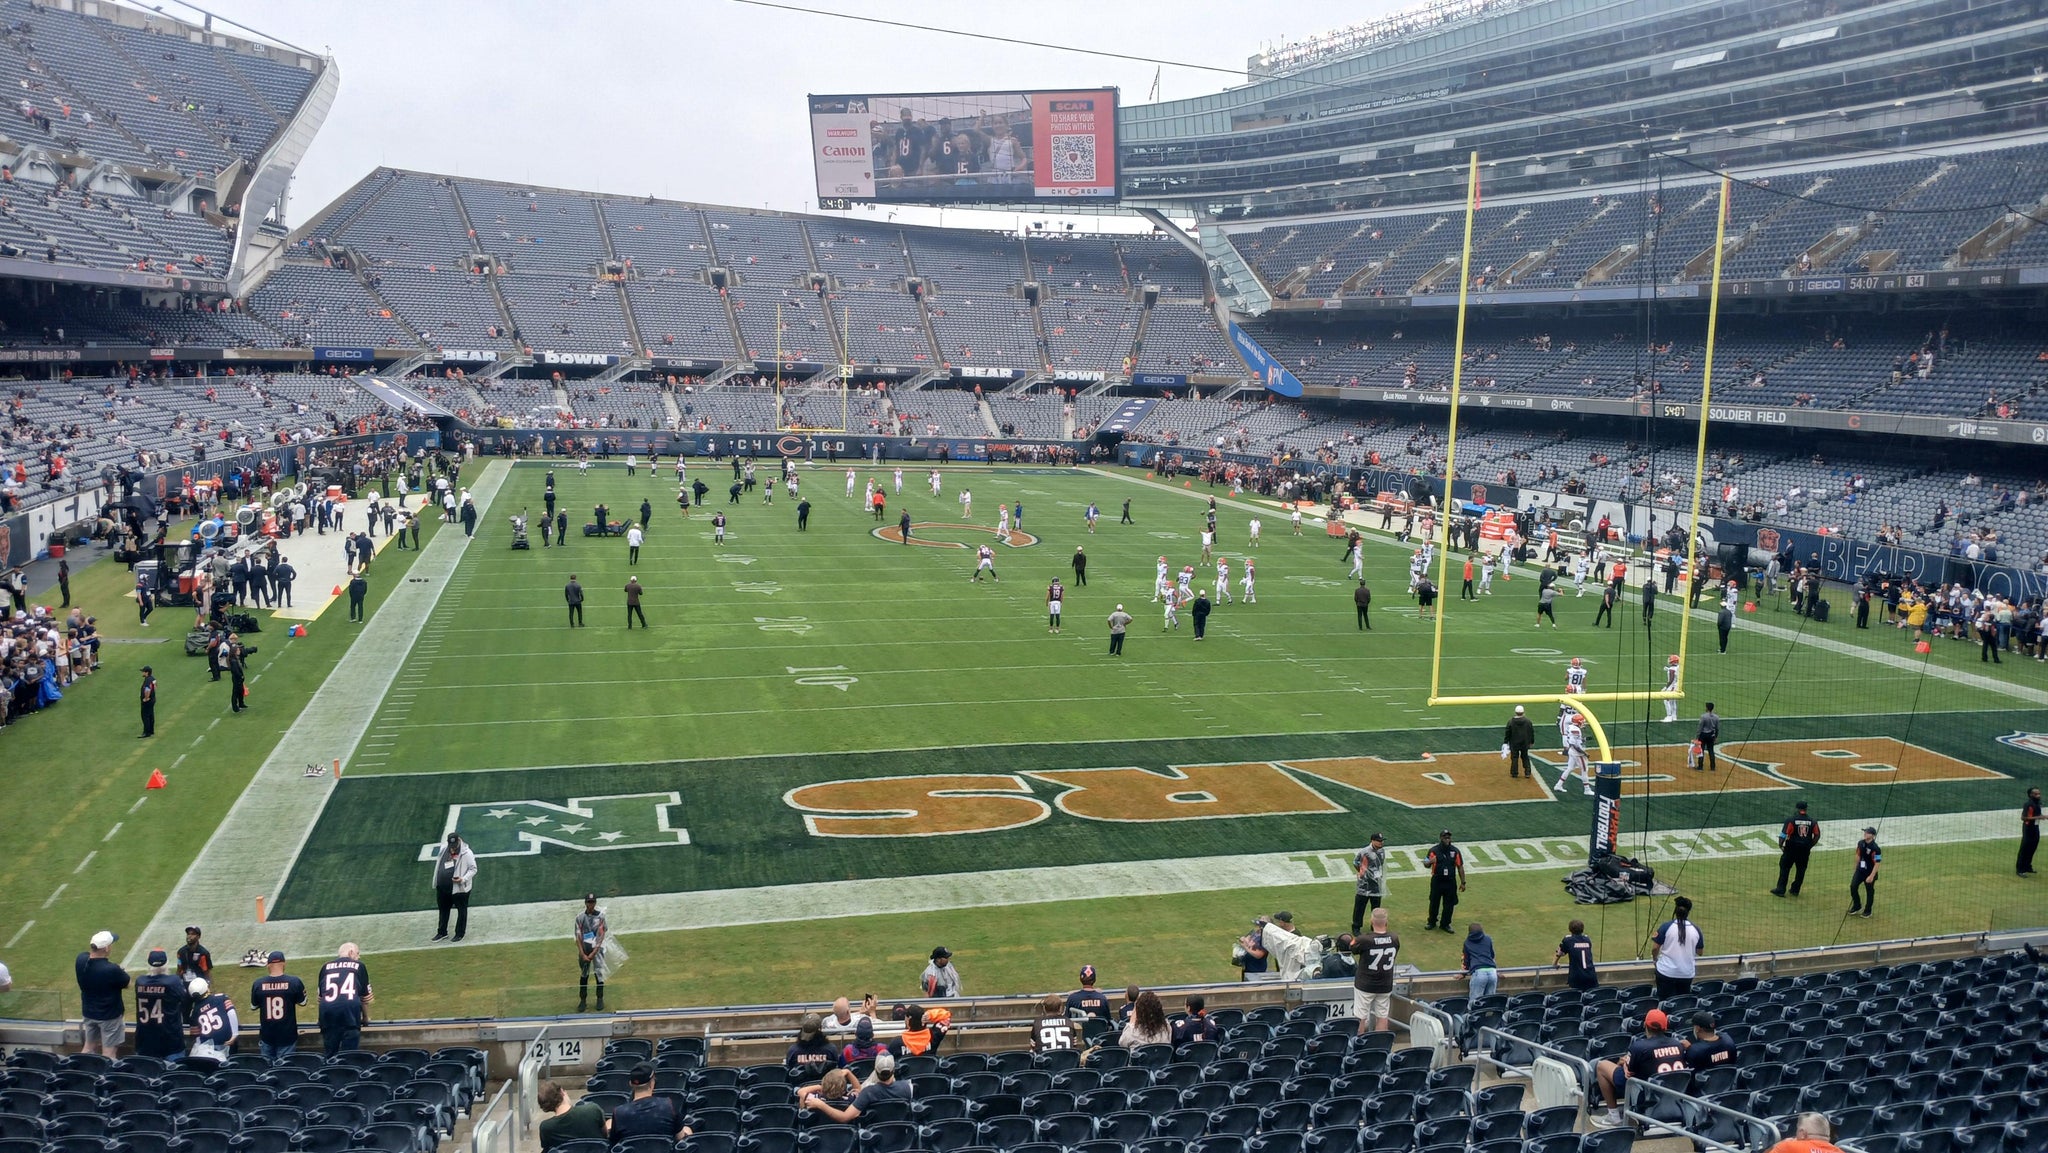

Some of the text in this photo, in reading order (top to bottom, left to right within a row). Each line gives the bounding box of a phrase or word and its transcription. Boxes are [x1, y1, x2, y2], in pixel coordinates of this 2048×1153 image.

[1056, 102, 1088, 110] SCAN
[1051, 113, 1094, 122] TO SHARE YOUR
[1051, 123, 1071, 131] PHOTOS
[1088, 122, 1095, 130] US
[823, 146, 866, 157] Canon
[1808, 280, 1841, 290] GEICO
[1850, 277, 1878, 290] 54:07
[1909, 275, 1921, 287] 34
[325, 350, 362, 358] GEICO
[444, 351, 497, 361] BEAR
[545, 352, 607, 365] DOWN
[962, 367, 1013, 378] BEAR
[1055, 371, 1104, 381] DOWN
[1273, 367, 1285, 386] PNC
[1425, 395, 1449, 404] Advocate
[1501, 399, 1526, 407] UNITED
[1559, 400, 1574, 410] PNC
[1709, 408, 1787, 423] SOLDIER FIELD
[1959, 421, 1978, 437] Lite
[1820, 535, 1925, 582] BEAR
[1571, 674, 1583, 685] 81
[783, 736, 2012, 838] BEARS
[1596, 795, 1614, 850] FOOTBALL
[1374, 936, 1392, 945] THOMAS
[1368, 946, 1397, 971] 73
[1581, 950, 1588, 970] 1
[326, 961, 359, 970] URLACHER
[262, 982, 289, 991] WILLIAMS
[325, 972, 356, 1002] 54
[266, 996, 284, 1020] 18
[1082, 999, 1101, 1008] CUTLER
[138, 997, 165, 1024] 54
[1328, 1003, 1345, 1018] 124
[198, 1007, 223, 1035] 85
[1041, 1018, 1066, 1027] GARRETT
[1039, 1026, 1071, 1050] 95
[558, 1041, 581, 1057] 124
[1653, 1046, 1680, 1059] PEPPERS
[797, 1054, 827, 1063] URLACHER
[1711, 1051, 1729, 1063] PAYTON
